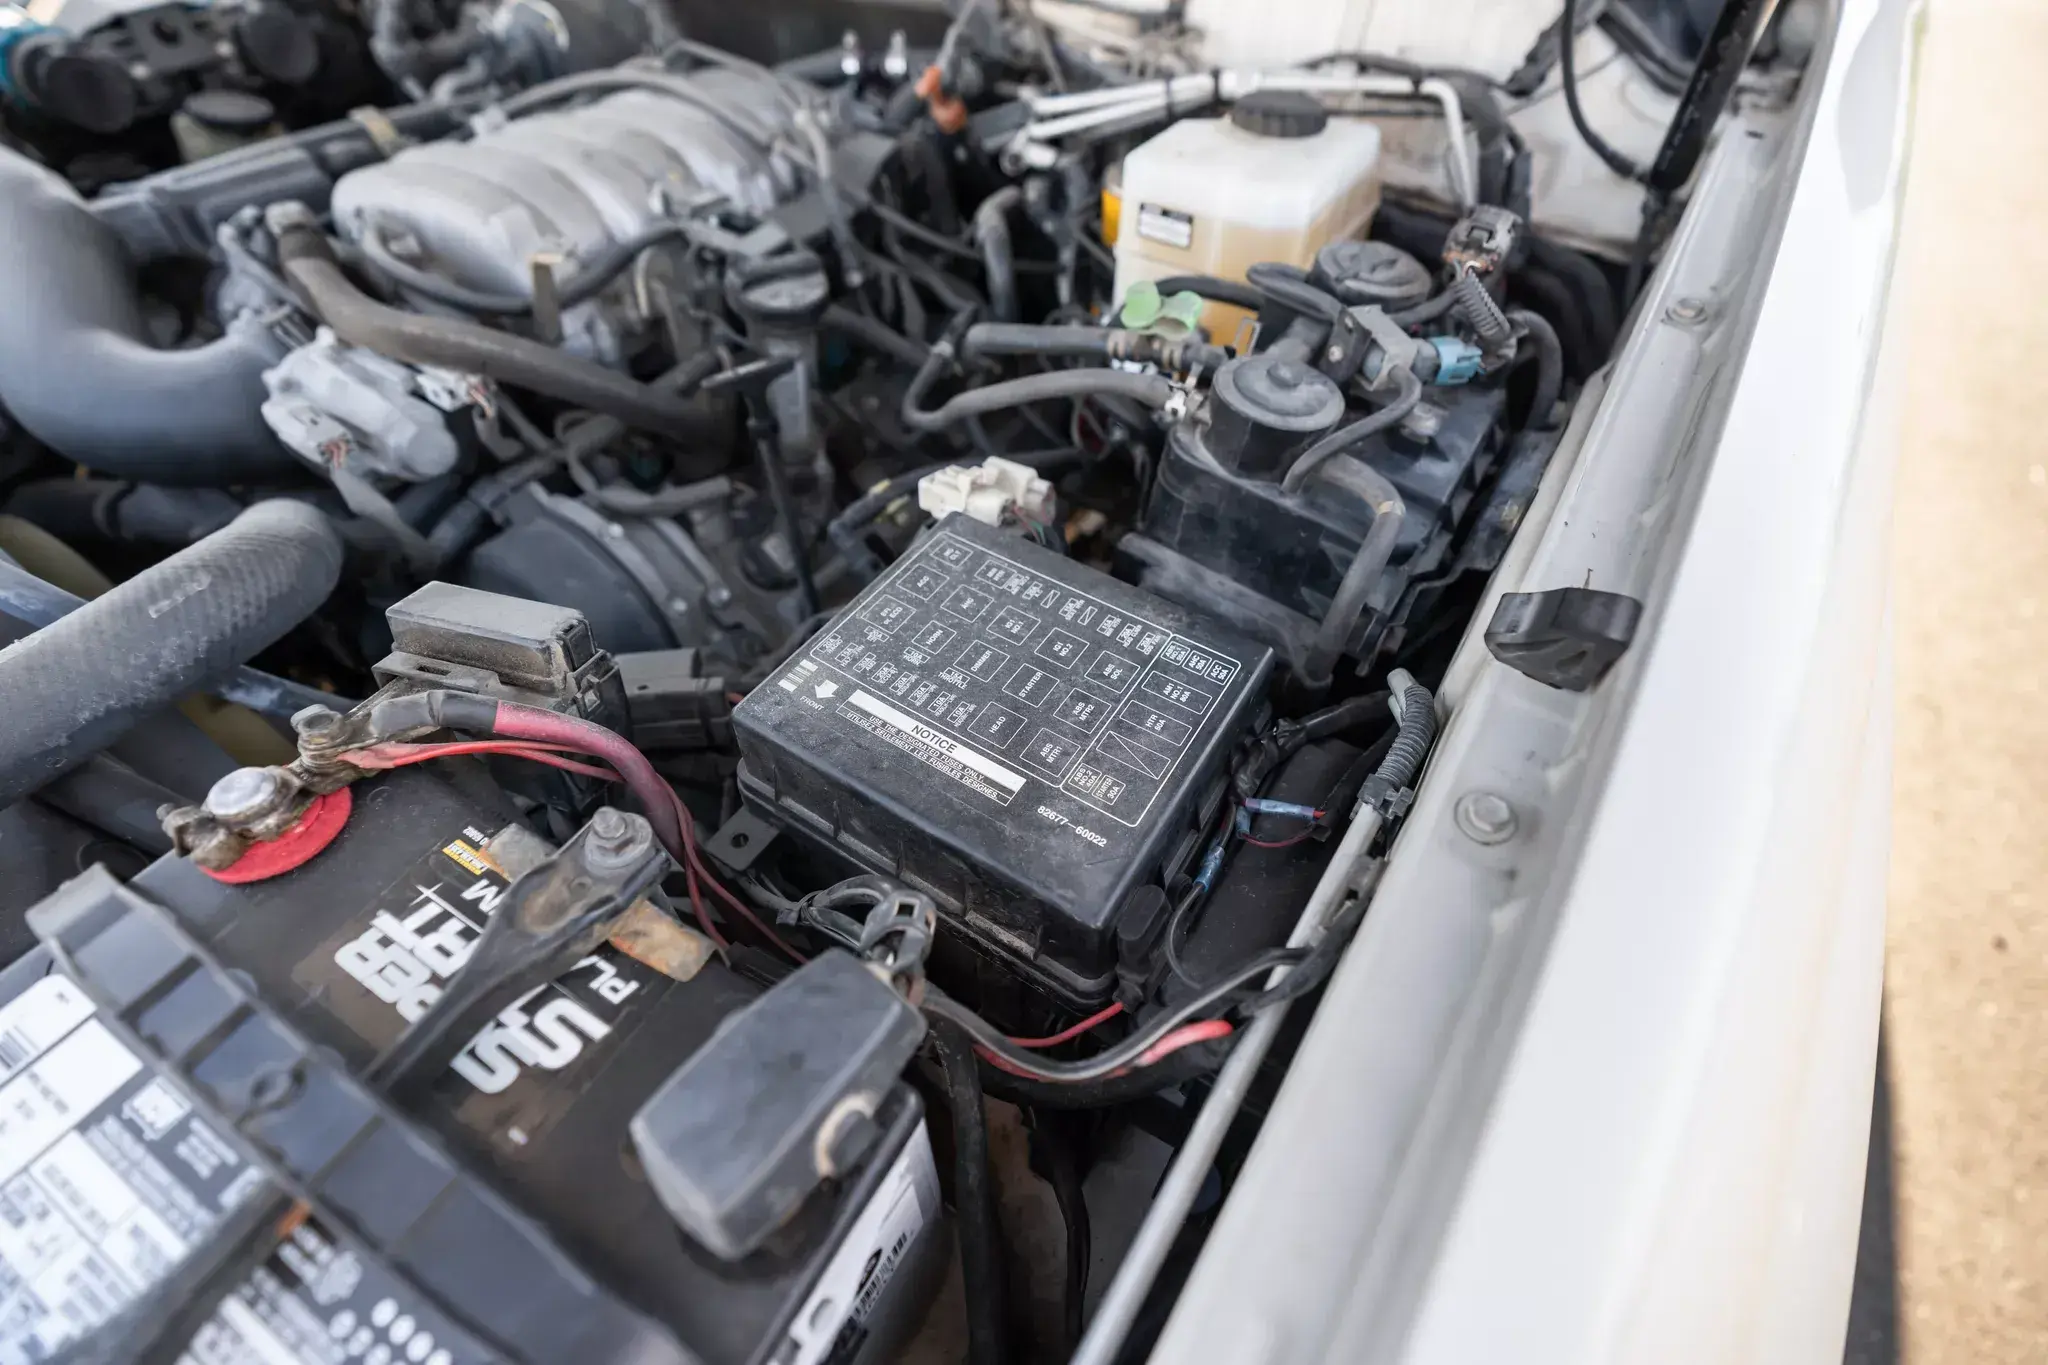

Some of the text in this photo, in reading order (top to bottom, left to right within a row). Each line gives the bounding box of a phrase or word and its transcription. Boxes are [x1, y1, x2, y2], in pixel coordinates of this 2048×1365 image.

[1010, 621, 1024, 634] NO.1
[925, 629, 943, 645] HORN
[1053, 641, 1063, 651] IG1
[1059, 643, 1073, 656] NO.2
[910, 651, 923, 660] 10A
[970, 650, 992, 672] DIMMER
[1188, 655, 1200, 668] AHC
[1103, 663, 1115, 676] ABS
[1195, 659, 1206, 670] 50A
[1210, 664, 1222, 678] ACC
[938, 672, 967, 689] THROTTLE
[1110, 668, 1123, 680] SOL
[1217, 669, 1228, 680] 50A
[895, 677, 908, 688] 20A
[1019, 671, 1043, 697] STARTER
[1163, 682, 1174, 695] AM1
[913, 687, 926, 698] 20A
[1170, 686, 1183, 700] NO.1
[799, 695, 824, 710] FRONT
[933, 697, 946, 707] 10A
[1072, 702, 1085, 715] ABS
[952, 707, 965, 717] 10A
[1079, 704, 1094, 721] MTR2
[989, 716, 1006, 733] HEAD
[1145, 714, 1158, 727] HTR
[847, 712, 874, 730] UTILISEZ
[875, 728, 913, 751] SEULEMENT
[913, 749, 928, 760] LES
[929, 757, 961, 778] FUSIBLES
[911, 725, 957, 753] NOTICE
[869, 715, 984, 782] USE THE DESIGNATED FUSES ONLY.
[1040, 743, 1053, 757] ABS
[1046, 746, 1062, 763] MTR1
[1073, 768, 1086, 782] ABS
[1078, 770, 1093, 786] NO.2
[1086, 775, 1097, 787] 40A
[1096, 778, 1113, 797] STARTER
[1107, 786, 1120, 799] 30A
[1038, 806, 1107, 847] 82677-60022
[332, 924, 539, 1094] SPER
